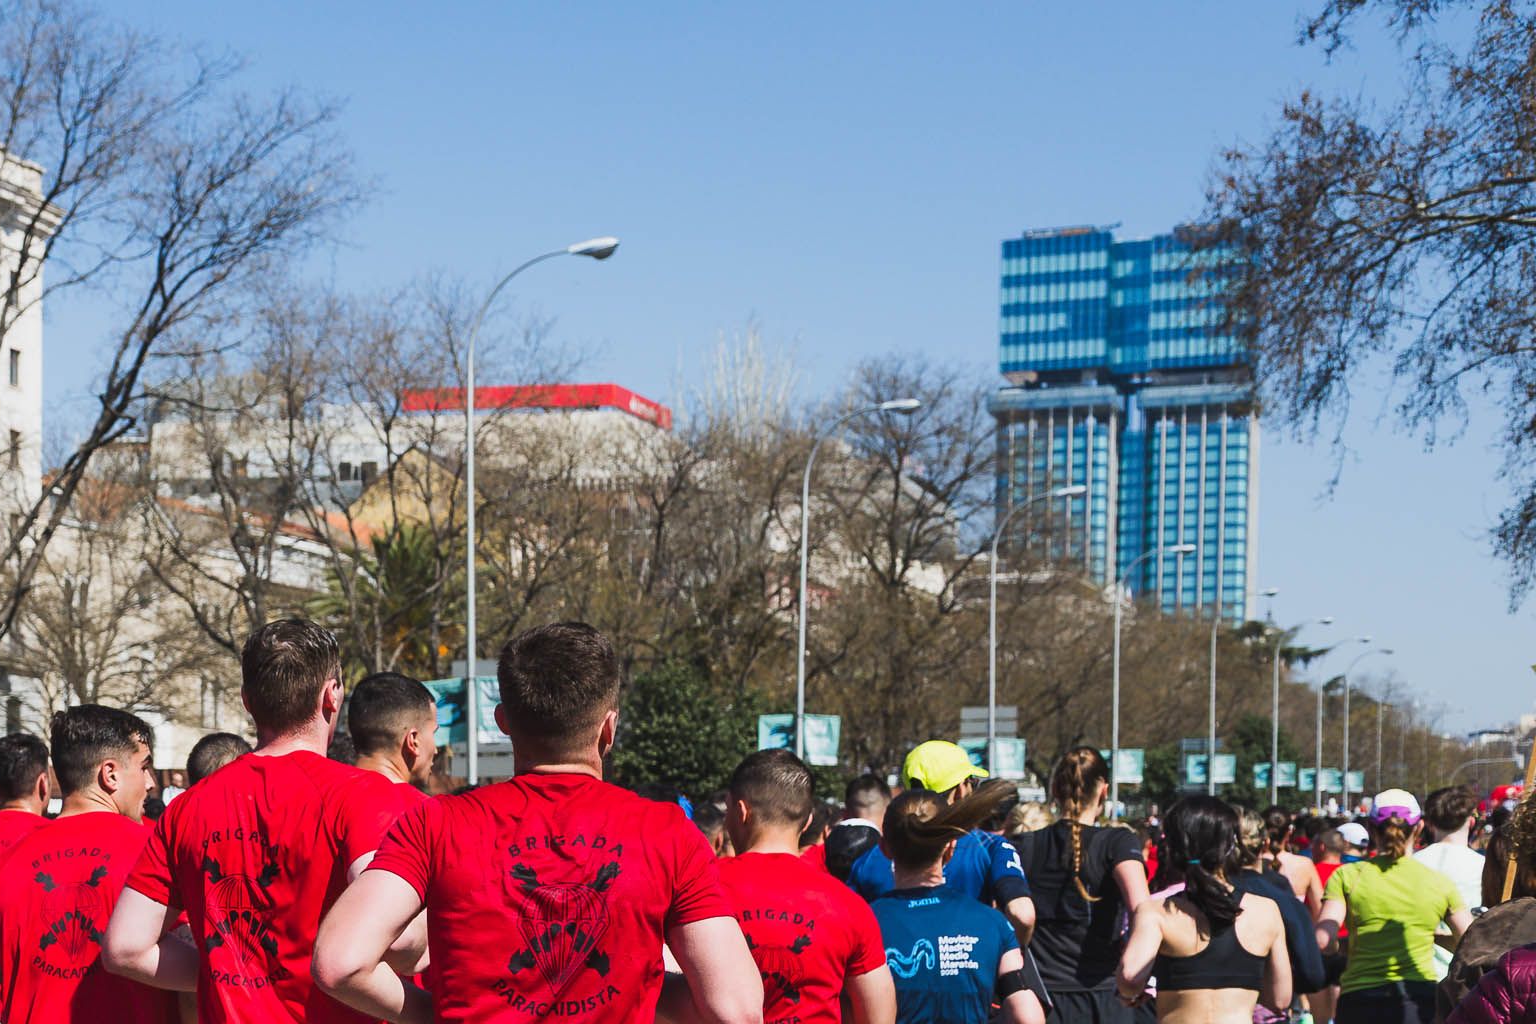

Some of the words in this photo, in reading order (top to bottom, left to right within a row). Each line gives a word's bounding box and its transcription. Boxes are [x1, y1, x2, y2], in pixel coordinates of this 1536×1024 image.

[508, 834, 624, 858] BRIGADA
[32, 848, 112, 869] BRIGADA
[742, 908, 815, 931] RIGADA
[939, 943, 973, 953] Madrid
[939, 951, 970, 961] Medio
[492, 978, 621, 1018] PARACAIDISTA
